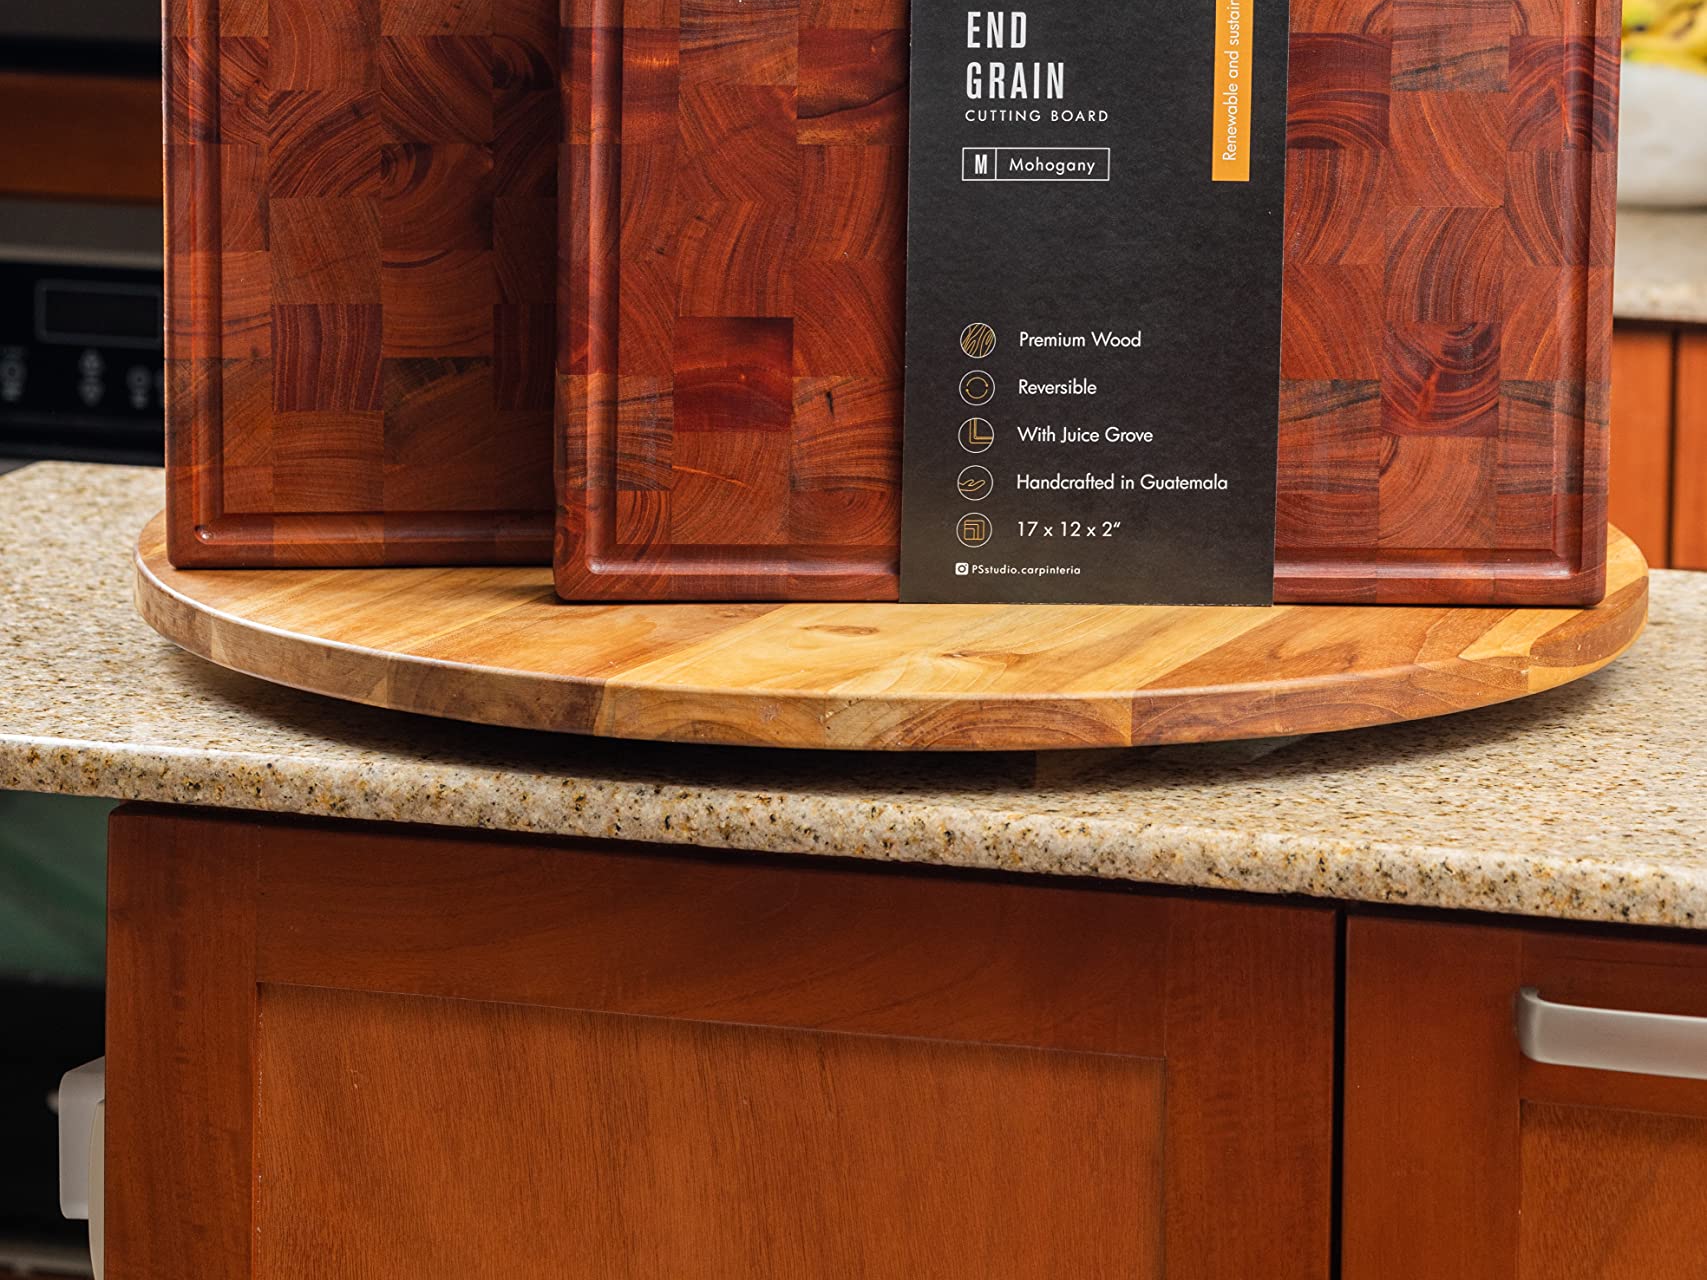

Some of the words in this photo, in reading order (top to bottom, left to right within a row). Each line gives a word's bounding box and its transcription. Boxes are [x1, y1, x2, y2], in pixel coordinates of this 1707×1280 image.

[968, 12, 1026, 48] END
[1224, 51, 1239, 78] and
[967, 62, 1063, 99] GRAIN
[965, 110, 1040, 121] CUTTING
[1051, 110, 1107, 121] BOARD
[1222, 83, 1238, 160] Renewable
[975, 154, 987, 174] M
[1010, 157, 1095, 175] Mohogany
[1020, 332, 1085, 347] Premium
[1091, 331, 1141, 347] Wood
[1019, 378, 1096, 394] Reversible
[1017, 426, 1055, 441] With
[1061, 427, 1099, 443] Juice
[1105, 427, 1153, 442] Grove
[1017, 473, 1114, 489] Handcrafted
[1121, 475, 1134, 489] in
[1141, 473, 1227, 489] Guatemala
[1018, 522, 1038, 536] 17
[1044, 527, 1052, 536] x
[1061, 522, 1080, 536] 12
[1087, 527, 1095, 536] x
[972, 565, 1080, 576] PSstudio.carpinteria
